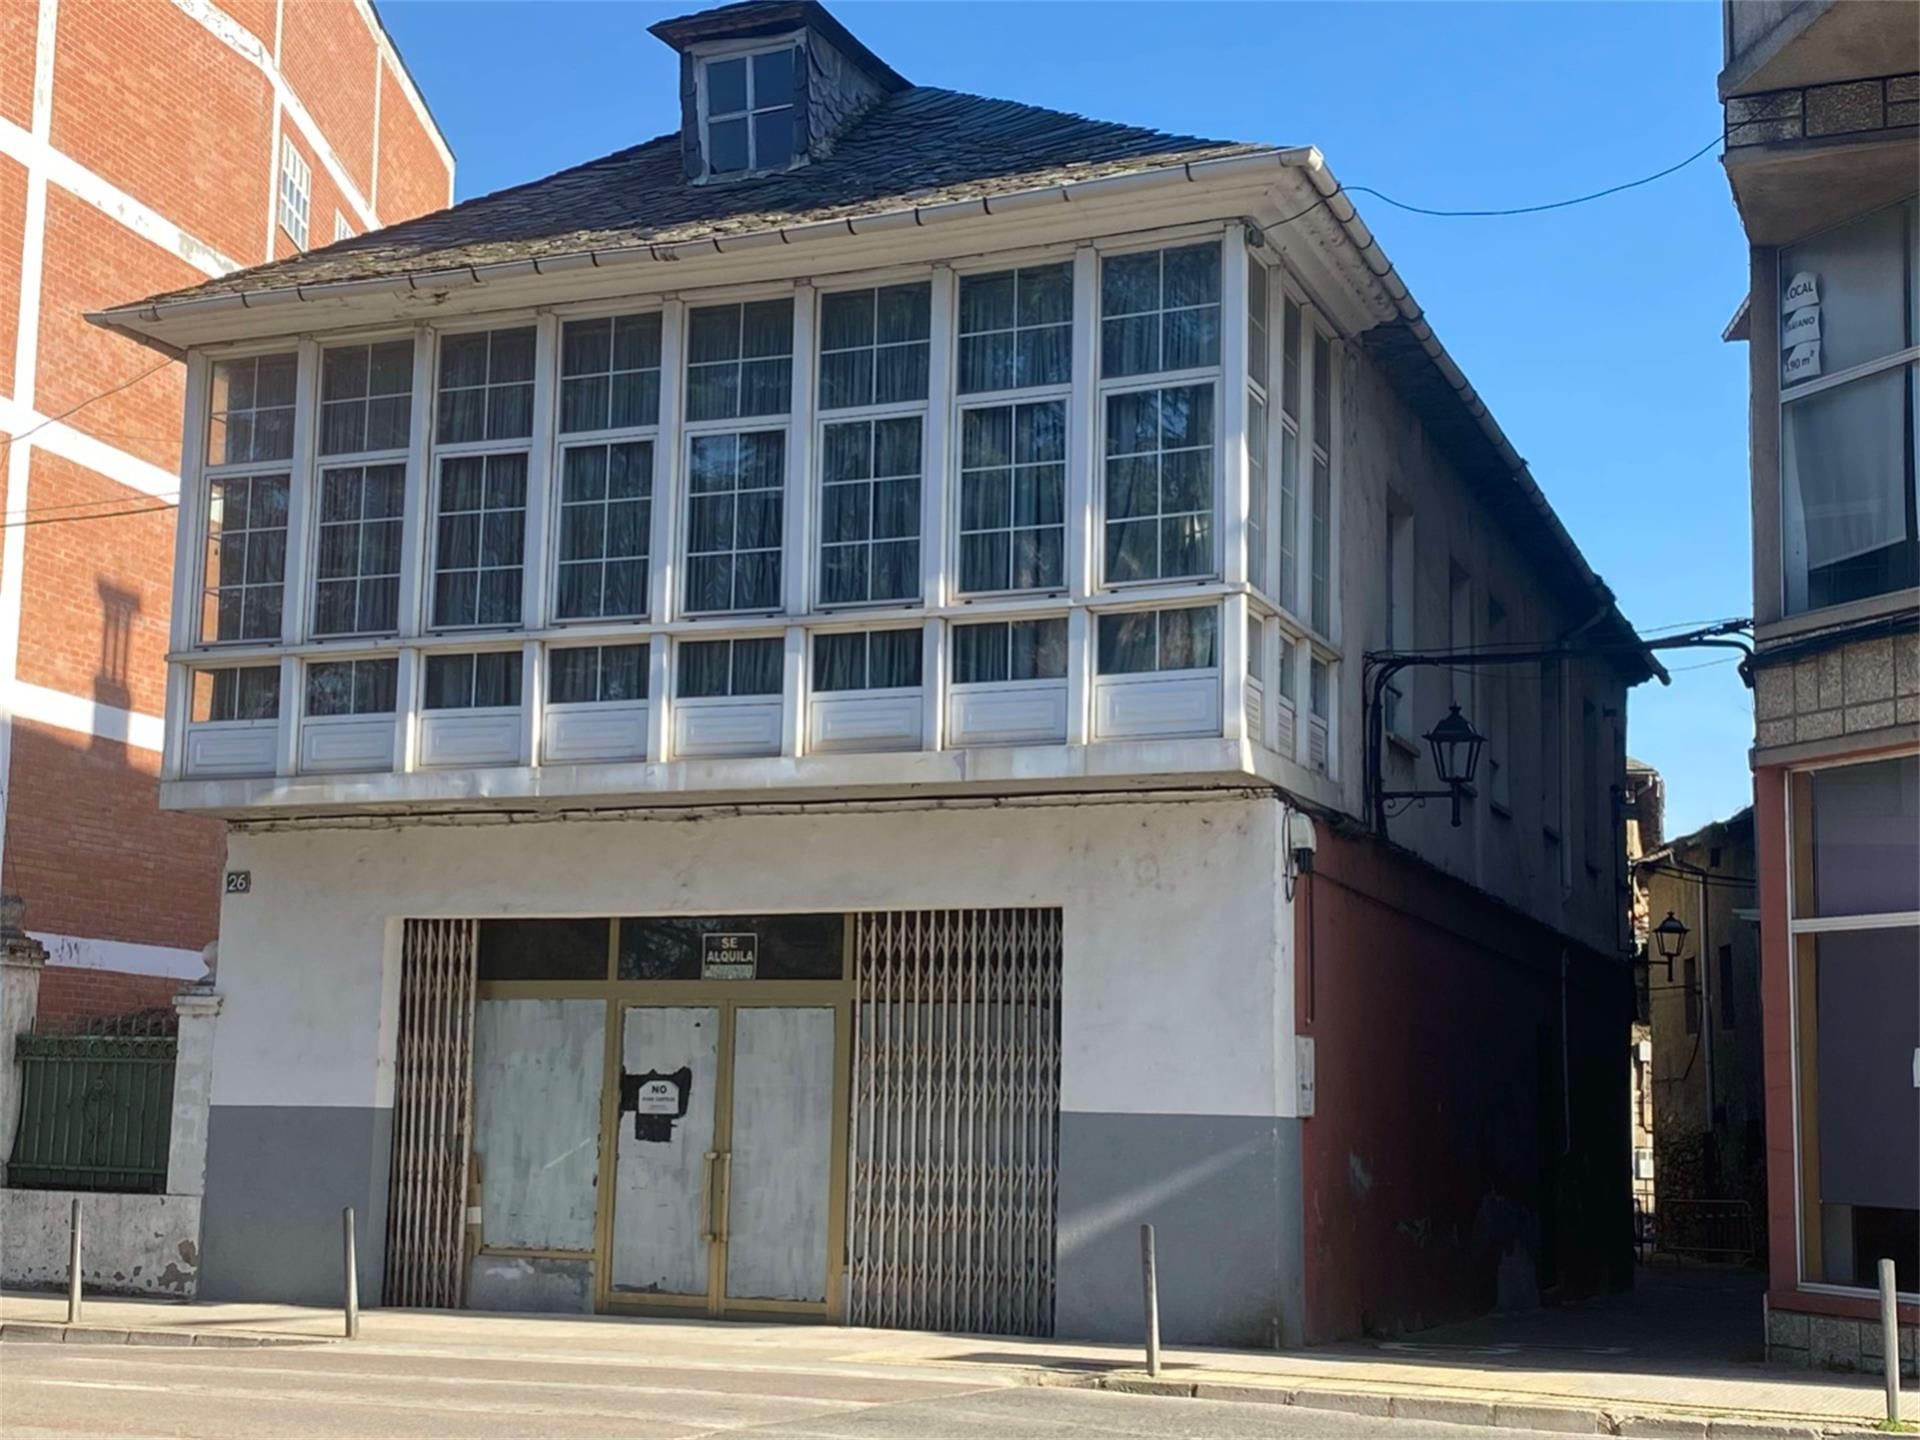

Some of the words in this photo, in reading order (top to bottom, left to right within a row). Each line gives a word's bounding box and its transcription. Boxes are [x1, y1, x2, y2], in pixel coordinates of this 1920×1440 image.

[228, 874, 246, 890] 26
[721, 937, 739, 949] SE
[706, 950, 754, 962] ALQUILA
[651, 1084, 668, 1095] NO
